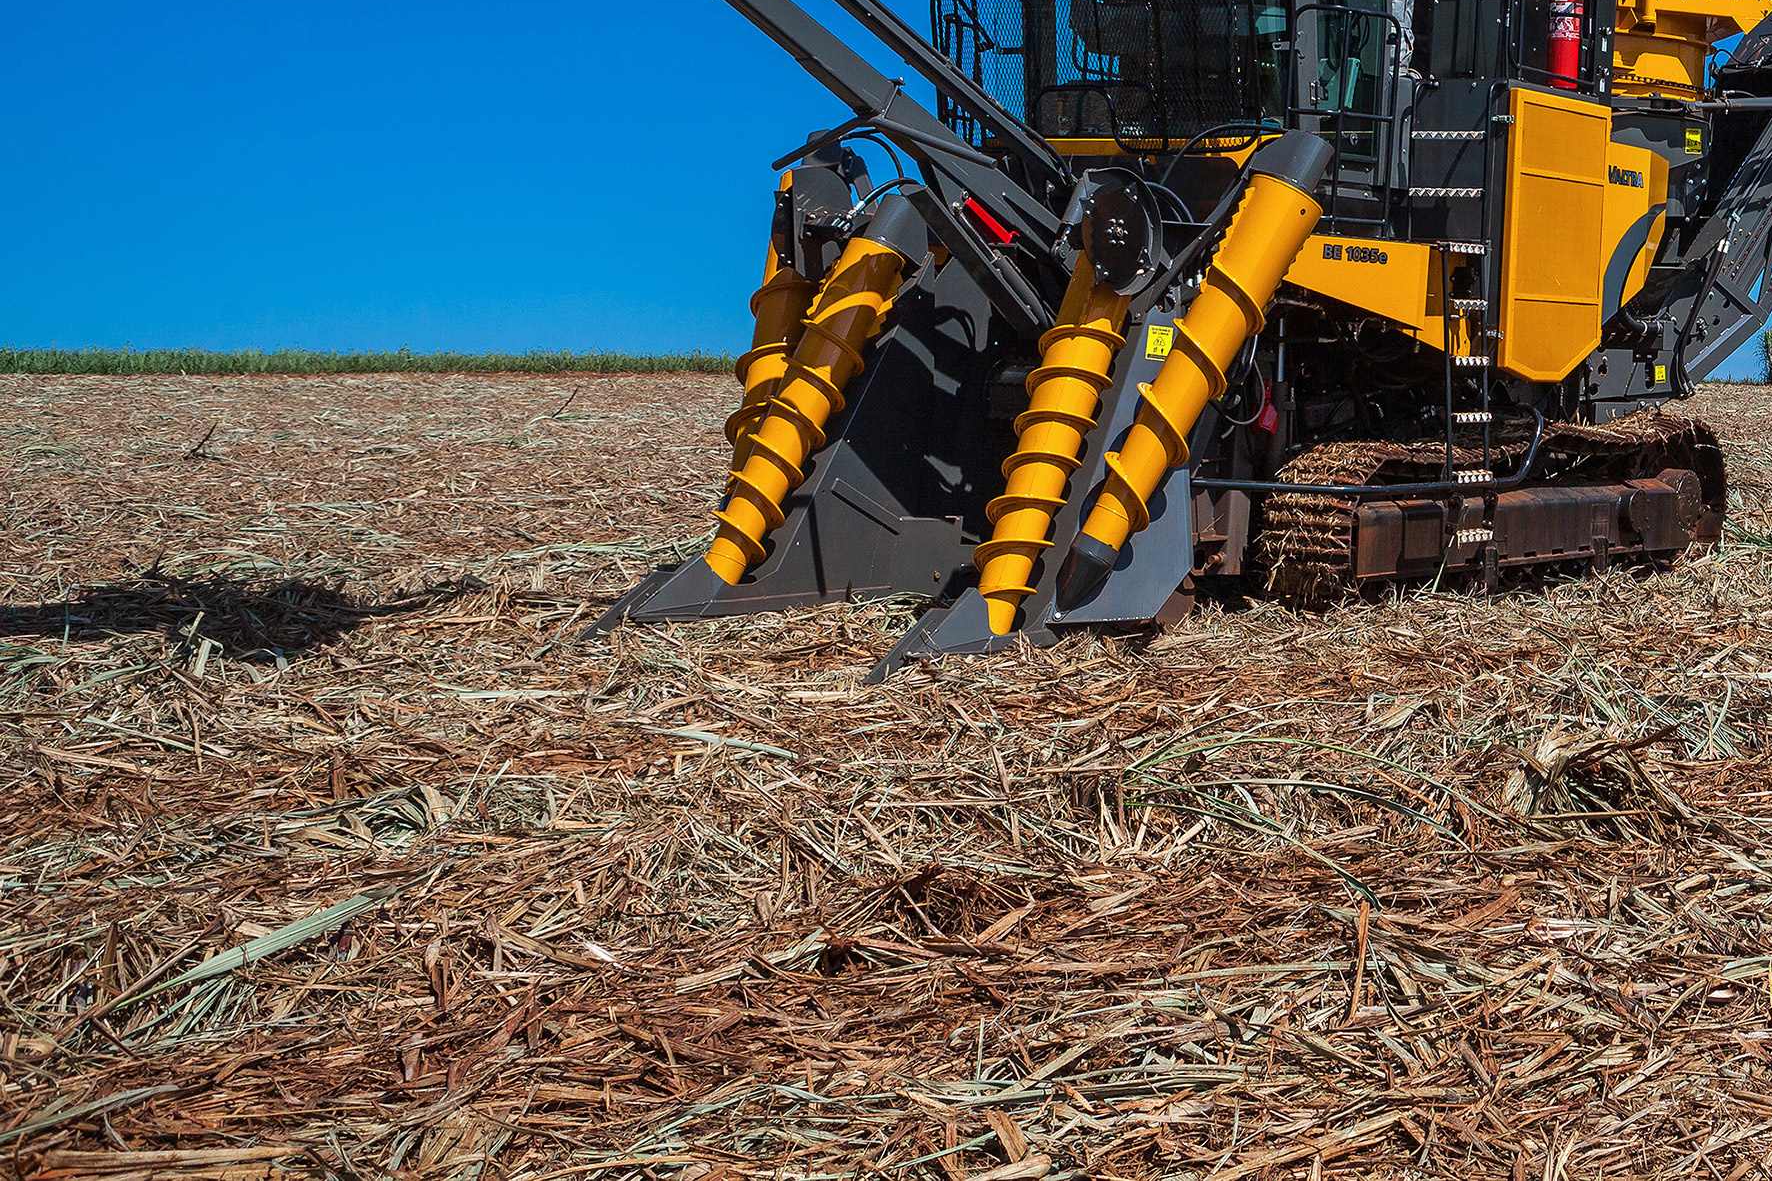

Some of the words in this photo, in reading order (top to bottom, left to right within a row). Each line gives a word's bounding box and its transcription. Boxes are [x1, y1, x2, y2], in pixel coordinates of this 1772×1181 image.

[1608, 164, 1645, 188] VALTRA
[1323, 244, 1343, 260] BE
[1345, 246, 1388, 265] 1035e
